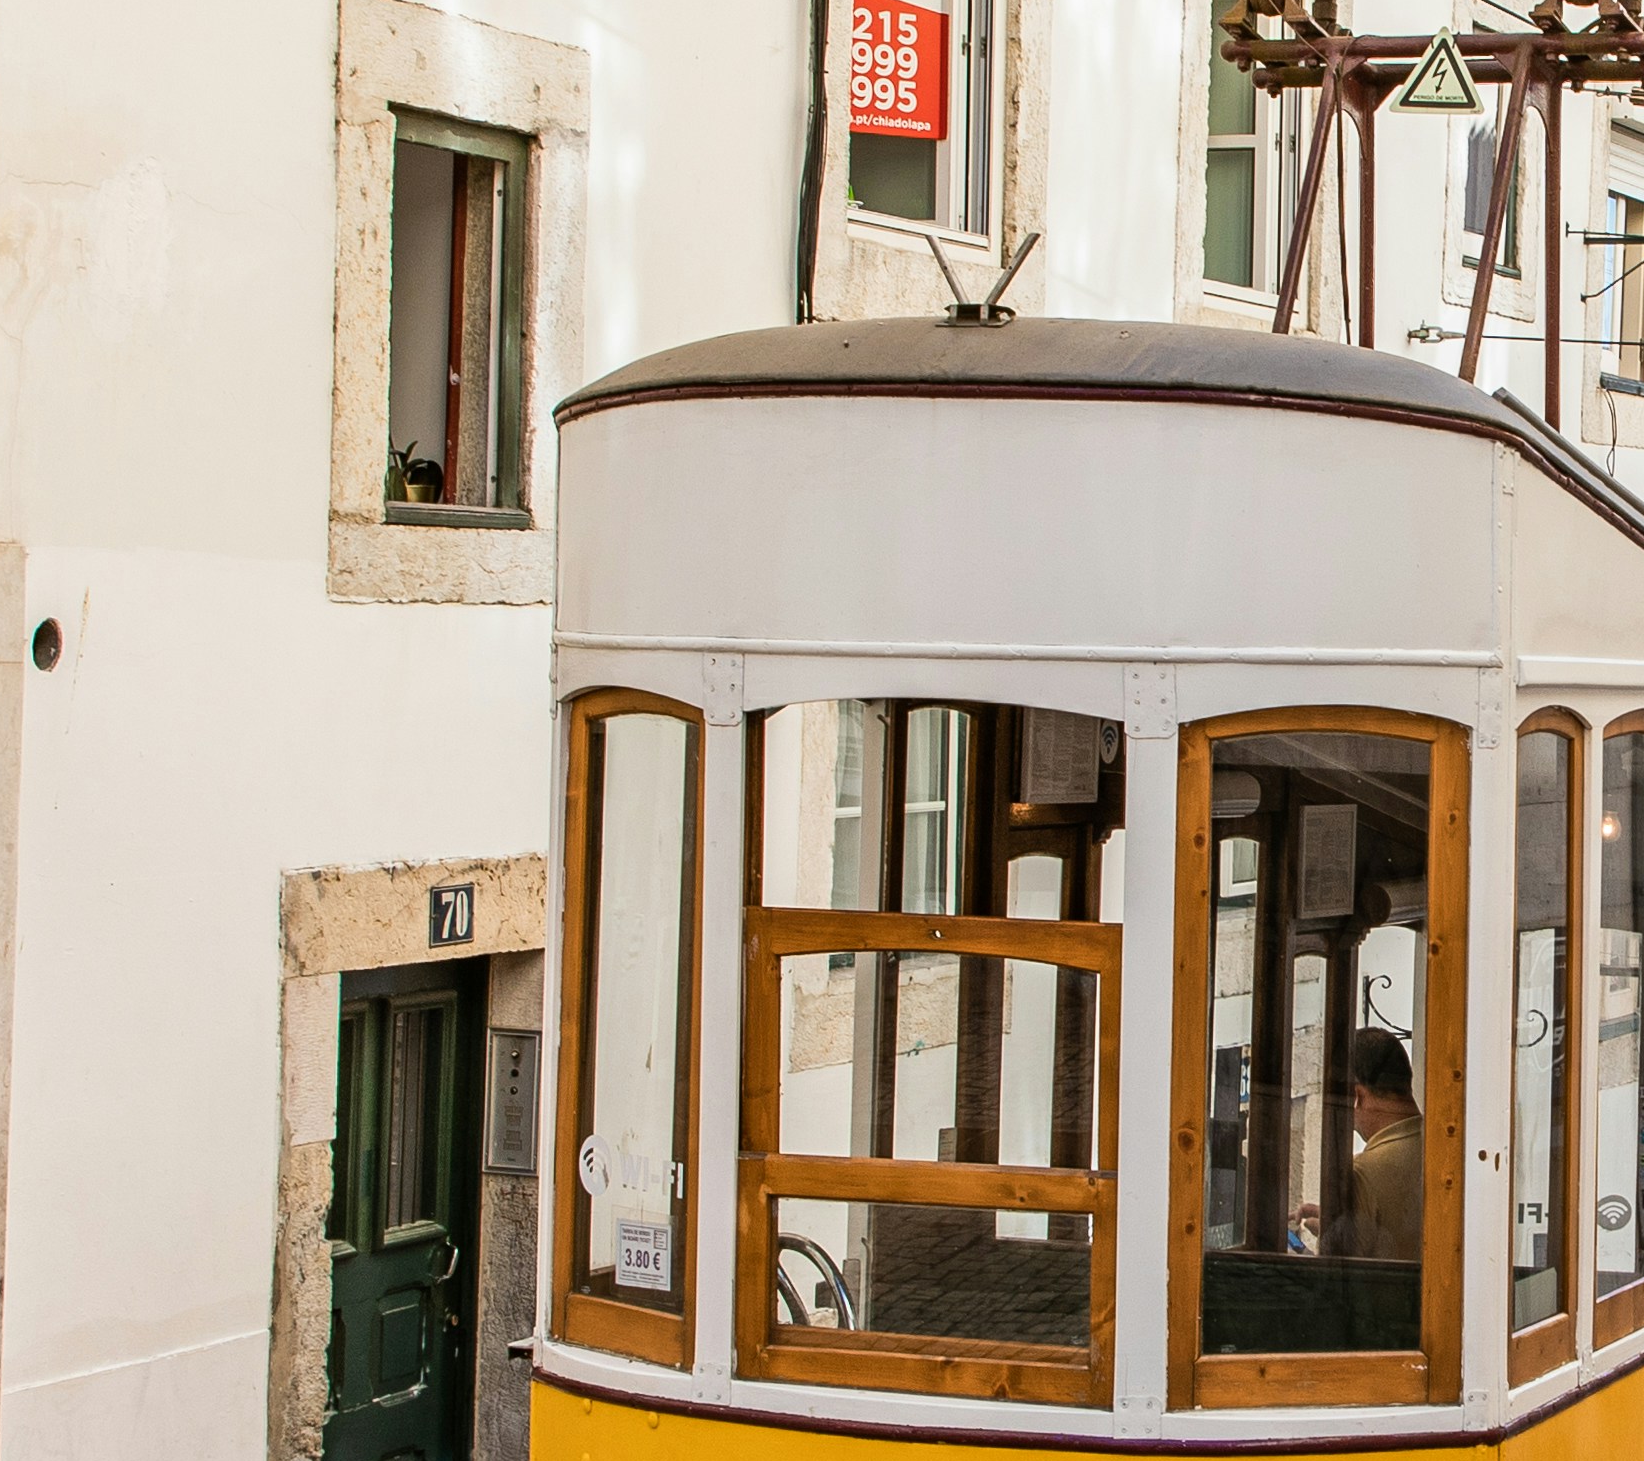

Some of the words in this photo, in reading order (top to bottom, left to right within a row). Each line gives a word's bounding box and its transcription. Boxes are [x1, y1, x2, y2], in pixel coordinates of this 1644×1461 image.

[853, 7, 918, 46] 215
[852, 41, 919, 80] 999
[851, 75, 918, 113] 995
[441, 890, 469, 940] 70
[620, 1154, 684, 1199] WI-FI
[625, 1248, 650, 1269] 3.80
[653, 1252, 661, 1271] €
